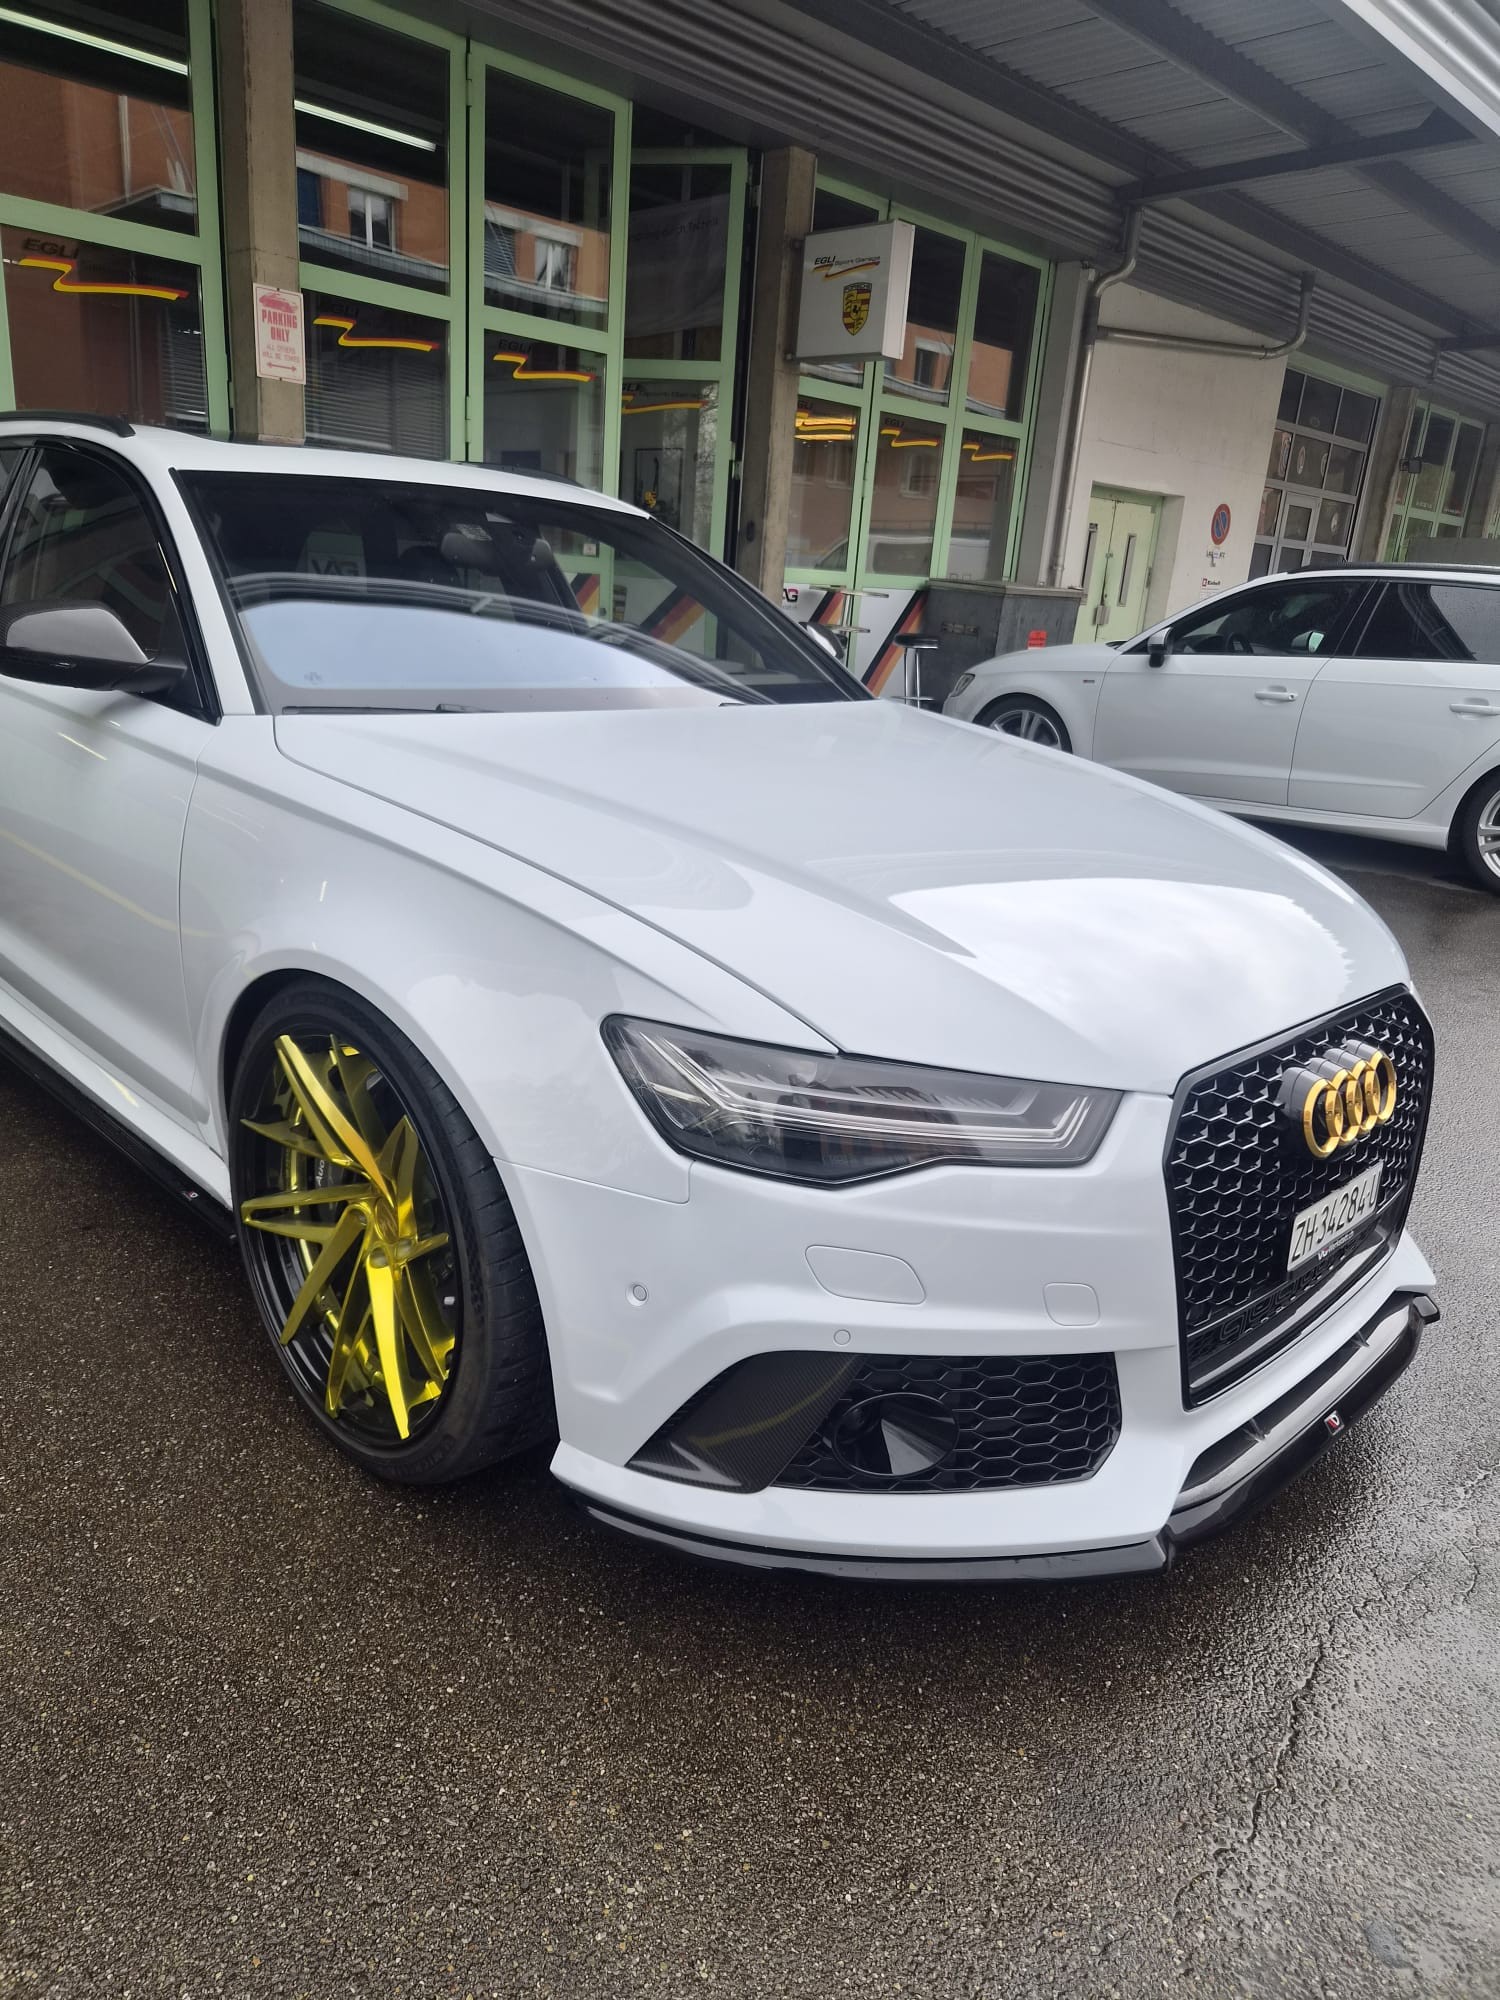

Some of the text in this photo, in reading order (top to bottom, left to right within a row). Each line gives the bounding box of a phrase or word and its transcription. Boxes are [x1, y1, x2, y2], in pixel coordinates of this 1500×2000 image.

[23, 237, 79, 259] EGLI
[814, 255, 836, 265] EGLI
[261, 308, 298, 329] PARKING
[270, 326, 290, 342] ONLY
